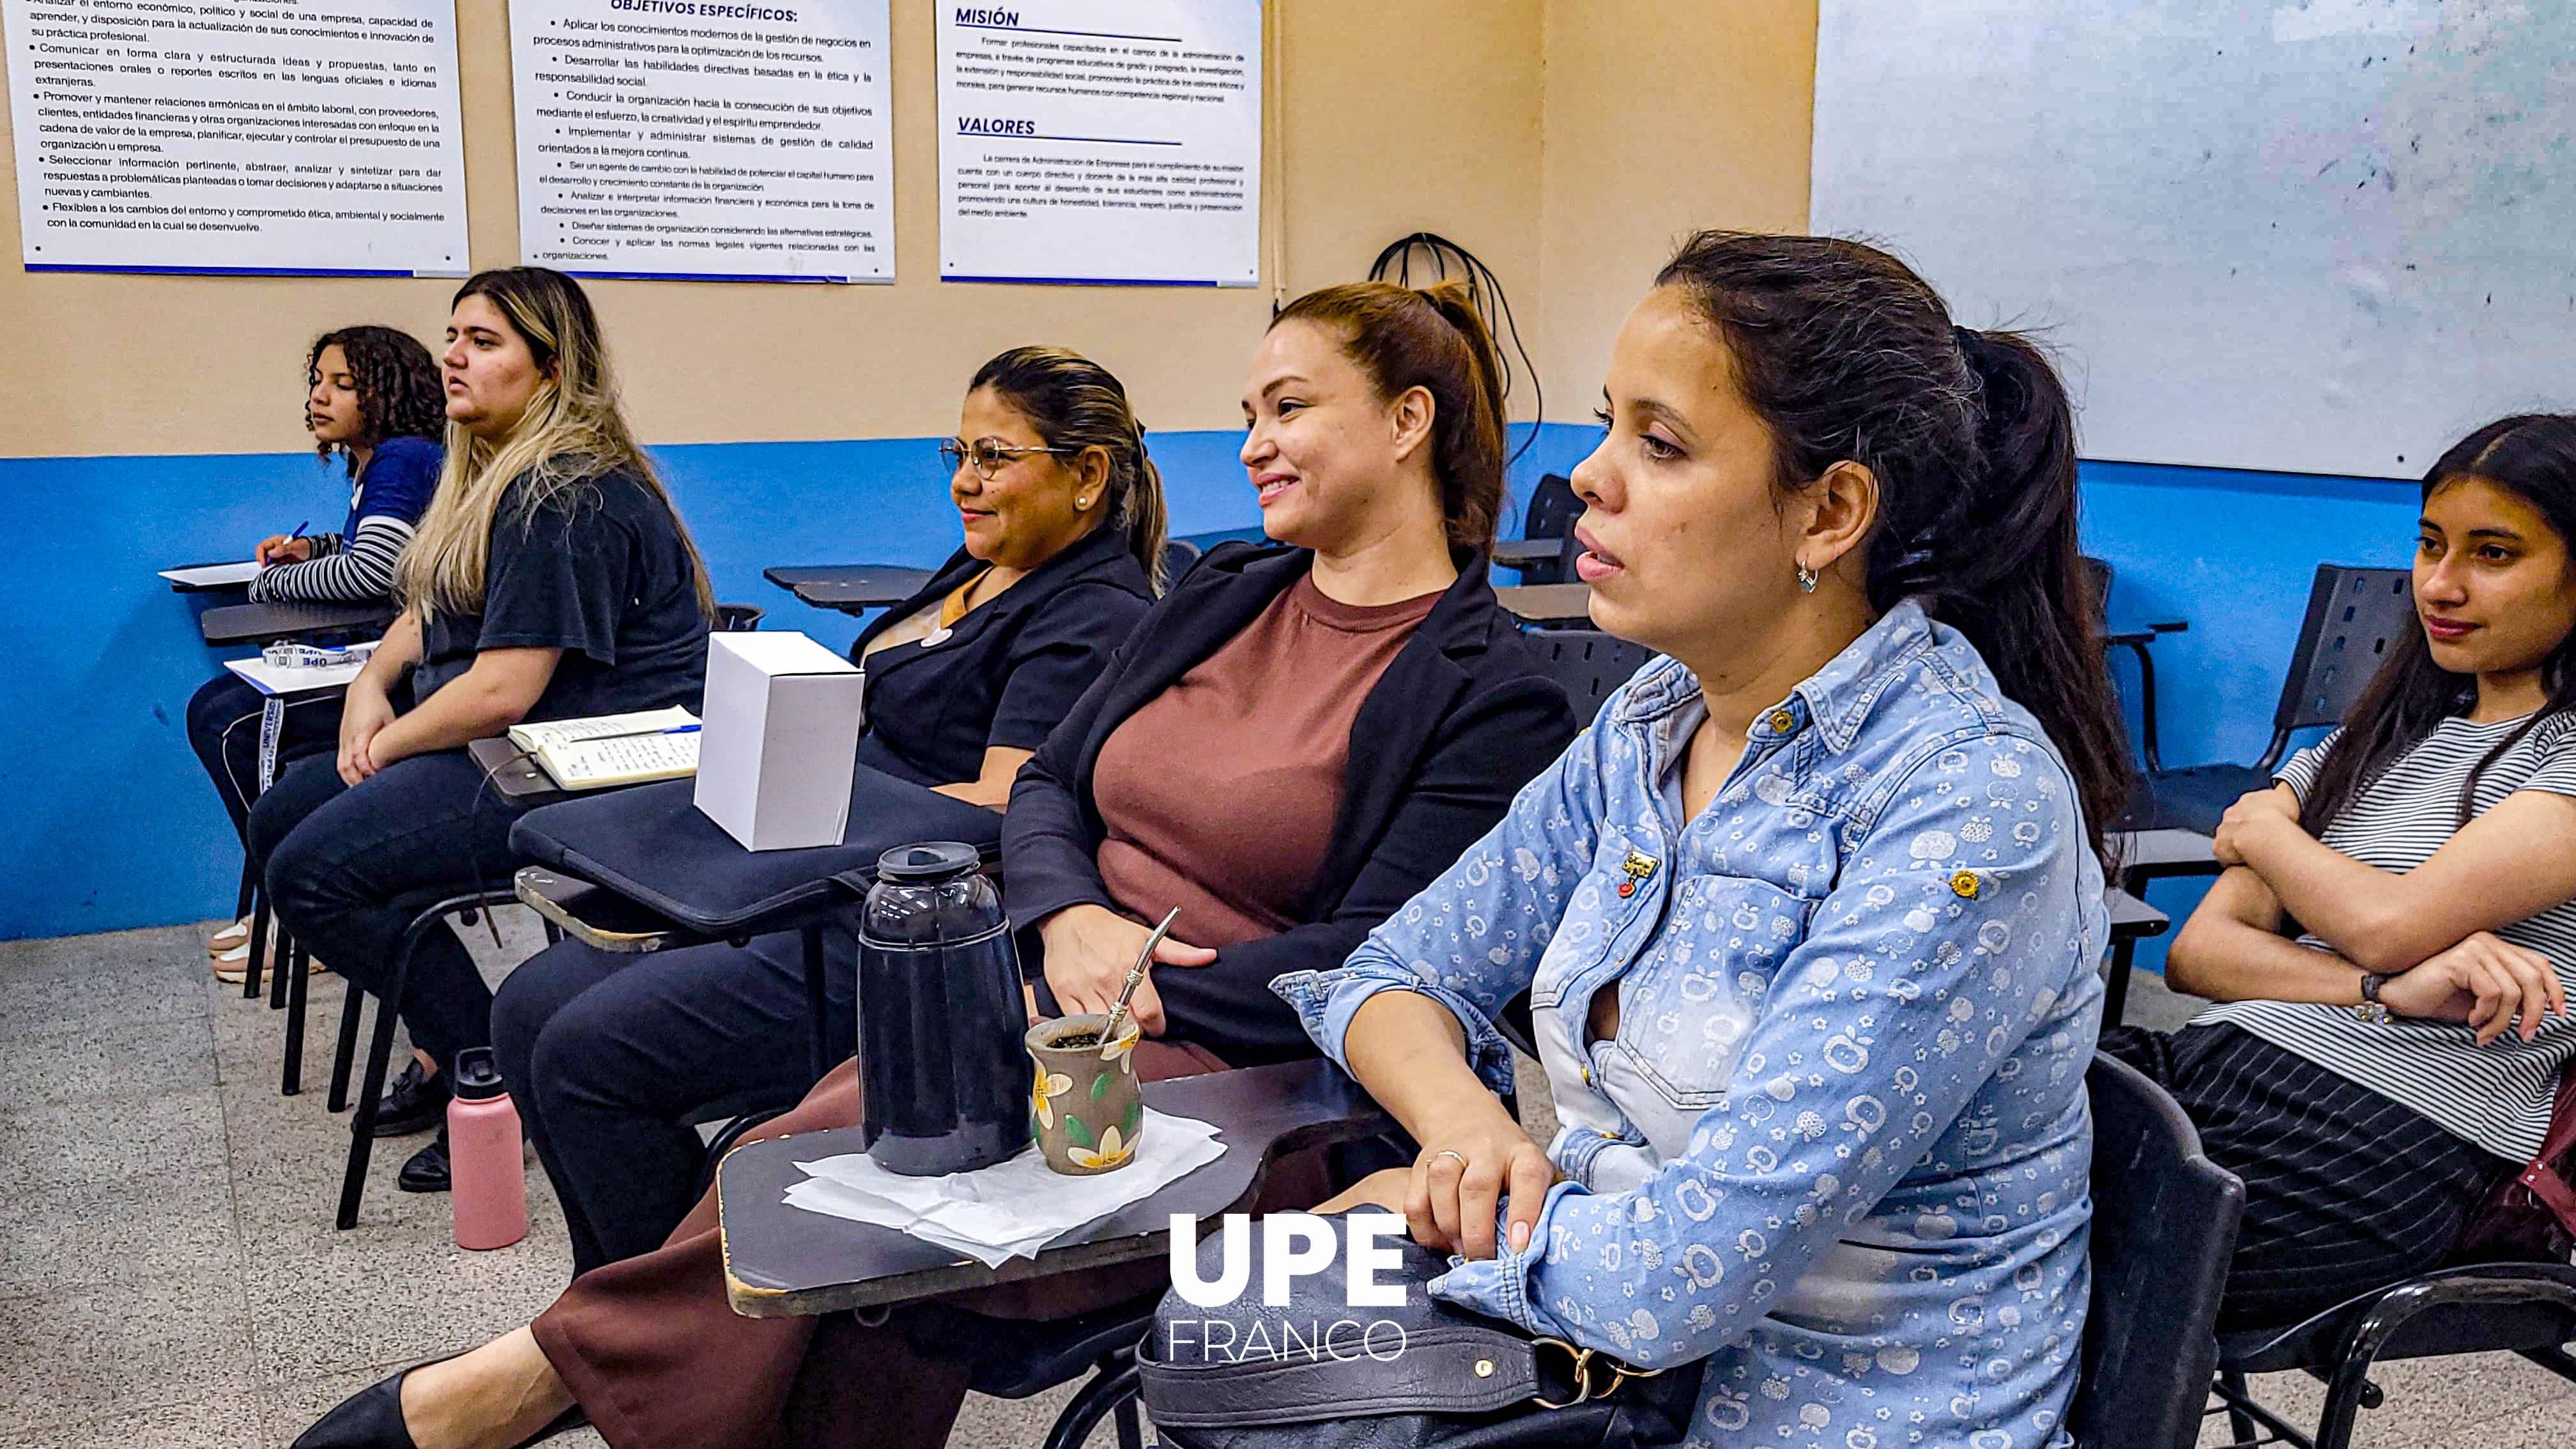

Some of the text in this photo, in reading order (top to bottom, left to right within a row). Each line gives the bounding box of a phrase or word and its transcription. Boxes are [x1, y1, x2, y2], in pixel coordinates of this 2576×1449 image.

[611, 0, 798, 22] OBJETIVOS ESPECÍFICOS:
[956, 6, 1020, 26] MISIÓN
[45, 28, 88, 39] práctica
[563, 18, 597, 31] Aplicar
[601, 20, 615, 32] los
[617, 24, 688, 37] conocimientos
[690, 28, 739, 40] modernos
[765, 33, 799, 44] gestión
[815, 38, 857, 48] negocios
[39, 43, 102, 56] Comunicar
[126, 47, 157, 59] forma
[164, 50, 190, 61] clara
[210, 53, 275, 65] estructurada
[282, 56, 310, 67] ideas
[328, 61, 387, 72] propuestas,
[393, 62, 417, 73] tanto
[533, 36, 580, 47] procesos
[581, 38, 656, 52] administrativos
[657, 44, 679, 54] para
[691, 46, 751, 58] optimización
[765, 49, 779, 60] los
[564, 54, 619, 67] Desarrollar
[624, 57, 639, 69] las
[643, 59, 699, 72] habilidades
[703, 63, 749, 75] directivas
[753, 66, 793, 78] basadas
[535, 72, 615, 85] responsabilidad
[43, 91, 93, 103] Promover
[103, 95, 151, 106] mantener
[155, 96, 206, 108] relaciones
[208, 100, 259, 111] armónicas
[287, 102, 319, 113] ámbito
[321, 103, 356, 116] laboral,
[358, 108, 376, 116] con
[378, 107, 438, 119] proveedores,
[566, 90, 611, 102] Conducir
[627, 96, 690, 107] organización
[693, 96, 719, 109] hacia
[734, 102, 794, 112] consecución
[812, 105, 829, 114] sus
[832, 105, 872, 117] objetivos
[38, 107, 81, 119] clientes,
[82, 109, 133, 120] entidades
[135, 111, 190, 123] financieras
[199, 114, 225, 124] otras
[226, 116, 300, 127] organizaciones
[302, 118, 356, 130] interesadas
[358, 123, 376, 131] con
[378, 121, 416, 134] enfoque
[536, 107, 583, 119] mediante
[594, 109, 640, 123] esfuerzo,
[651, 114, 704, 125] creatividad
[958, 118, 1036, 134] VALORES
[39, 123, 78, 134] cadena
[95, 125, 121, 135] valor
[148, 129, 195, 140] empresa,
[197, 129, 244, 142] planificar,
[245, 131, 285, 142] ejecutar
[294, 133, 337, 144] controlar
[349, 137, 407, 148] presupuesto
[422, 139, 440, 148] una
[538, 143, 591, 155] orientados
[611, 147, 644, 158] mejora
[49, 155, 112, 167] Seleccionar
[119, 157, 179, 169] información
[186, 160, 239, 172] pertinente,
[245, 162, 288, 174] abstraer,
[295, 164, 332, 174] analizar
[350, 165, 392, 176] sintetizar
[399, 169, 420, 178] para
[426, 168, 441, 178] dar
[45, 188, 82, 196] nuevas
[52, 202, 98, 213] Flexibles
[108, 203, 124, 213] los
[126, 204, 169, 215] cambios
[171, 205, 187, 215] del
[188, 206, 226, 216] entorno
[236, 208, 306, 218] comprometido
[335, 210, 380, 220] ambiental
[390, 211, 444, 221] socialmente
[79, 219, 136, 229] comunidad
[162, 220, 184, 230] cual
